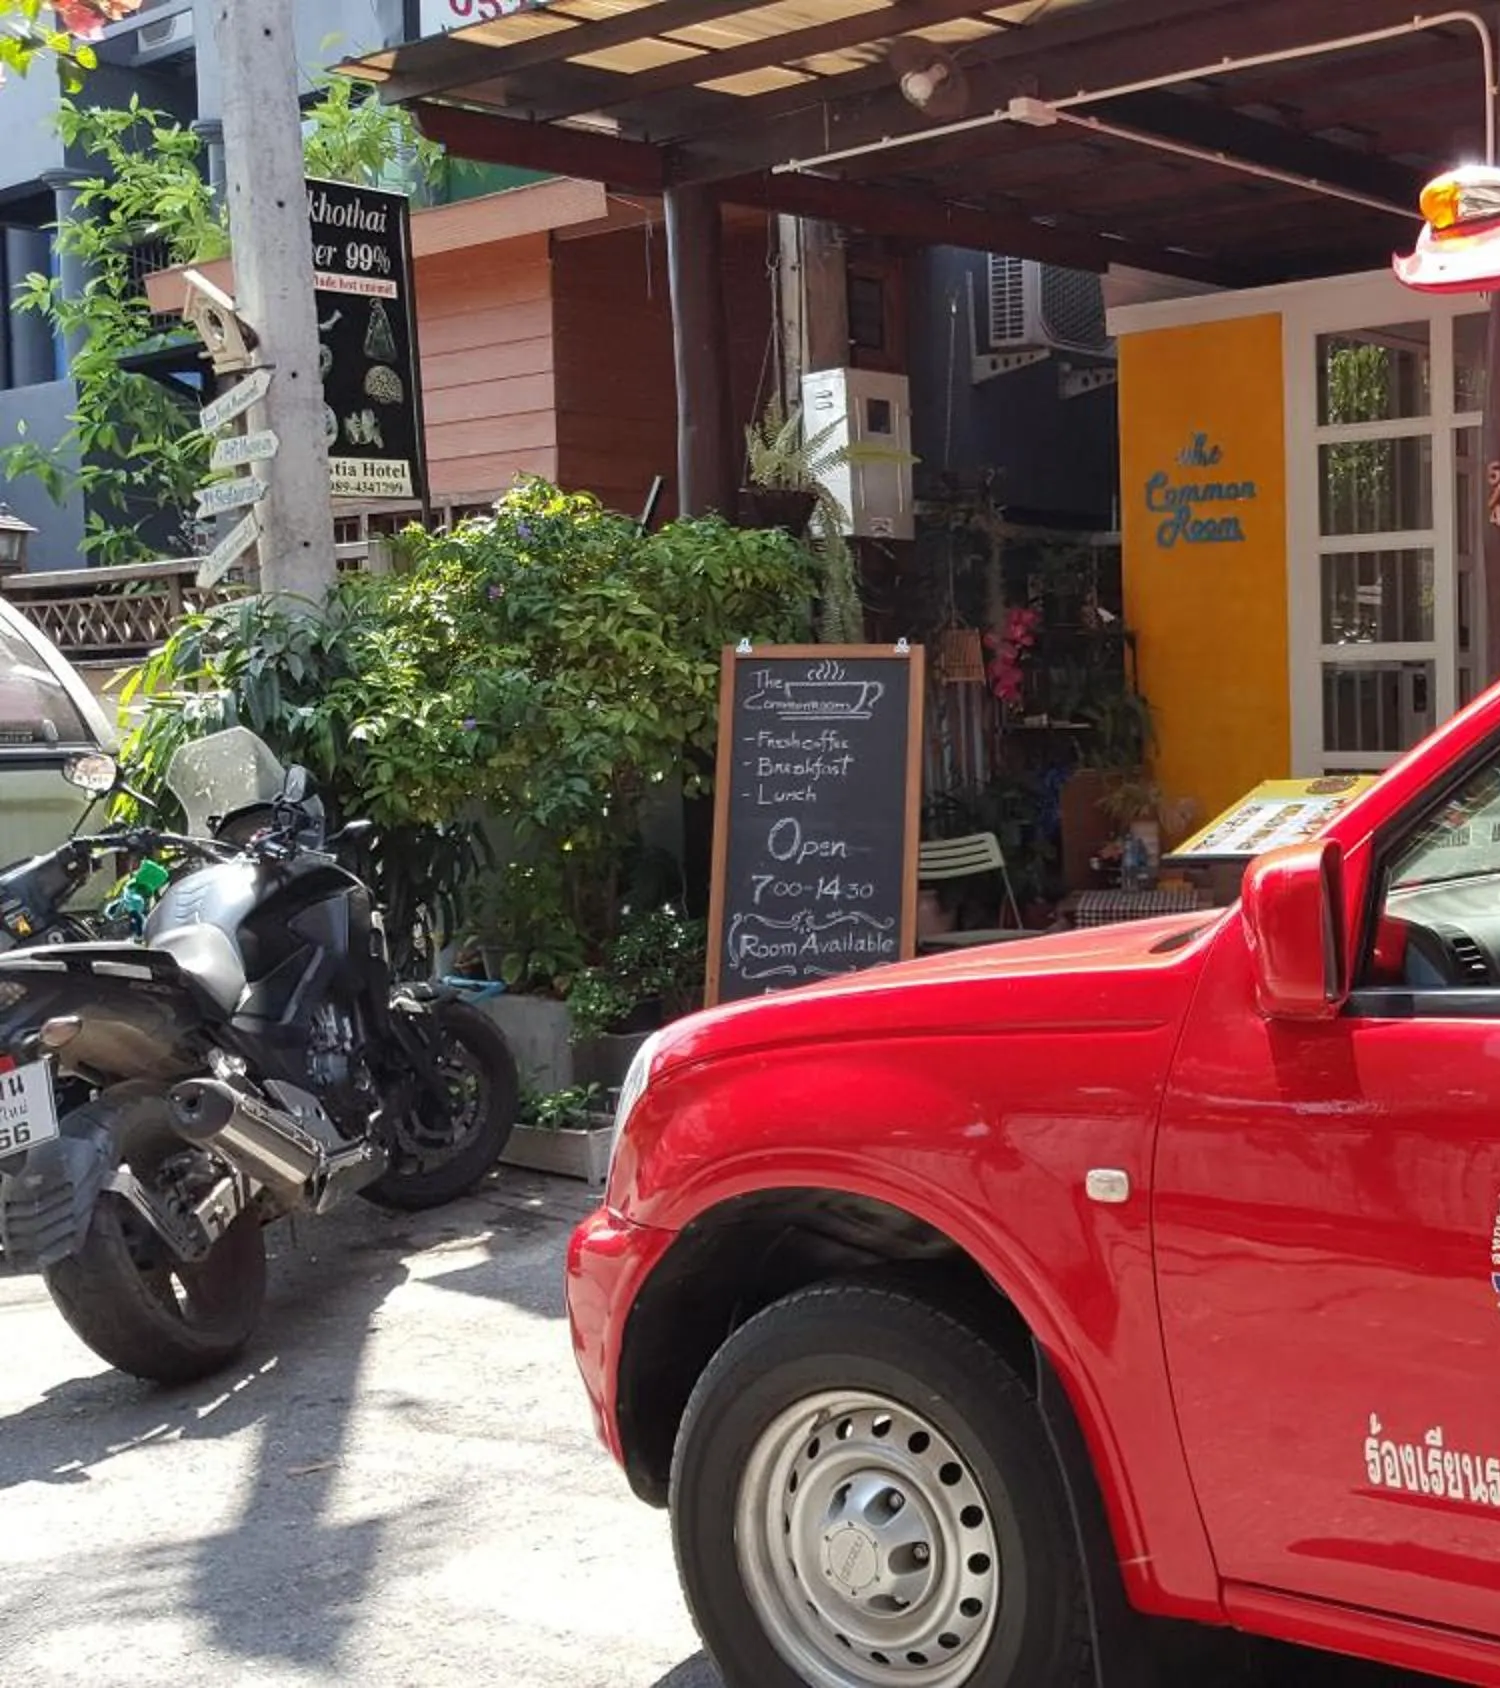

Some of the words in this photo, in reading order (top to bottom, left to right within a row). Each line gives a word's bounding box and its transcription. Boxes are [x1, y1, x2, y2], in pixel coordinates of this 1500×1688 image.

[310, 244, 338, 266] er
[346, 241, 391, 274] 99%
[361, 462, 406, 478] Hotel
[1145, 471, 1256, 513] Common
[1157, 504, 1245, 548] Room
[767, 817, 847, 864] Open
[740, 934, 796, 958] Room
[800, 931, 894, 955] Available
